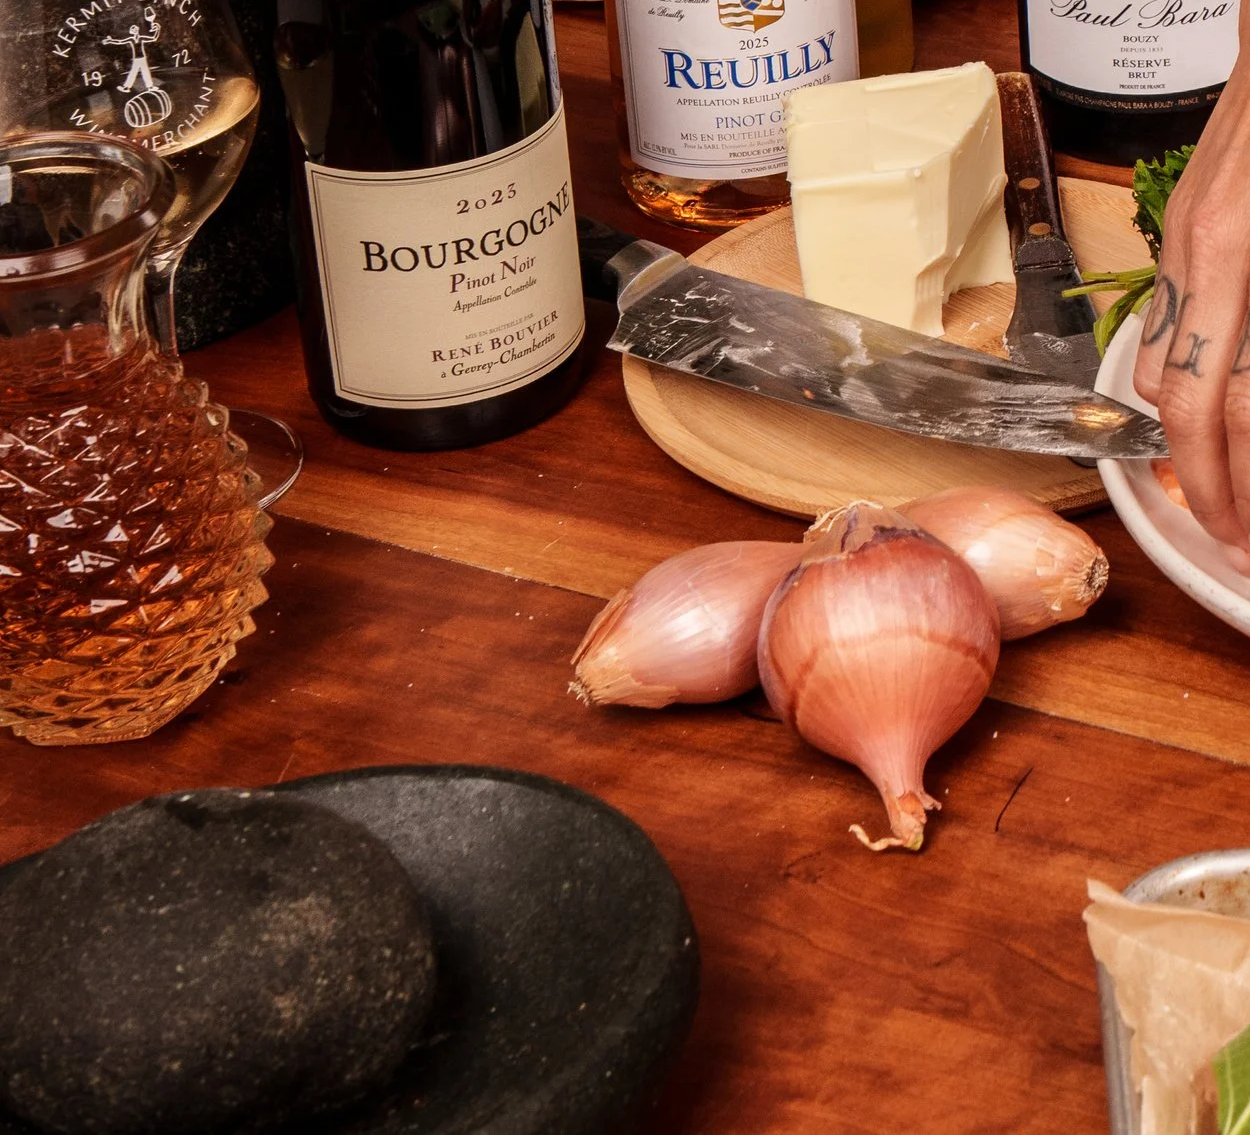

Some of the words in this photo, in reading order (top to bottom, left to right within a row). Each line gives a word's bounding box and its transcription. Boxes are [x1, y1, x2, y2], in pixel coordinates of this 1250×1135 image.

[739, 36, 769, 51] 2025
[1123, 35, 1159, 43] BOUZY
[81, 70, 103, 87] 19
[171, 49, 192, 67] 72
[658, 30, 836, 91] REUILLY
[1112, 57, 1171, 68] RÉSERVE
[1128, 71, 1157, 79] BRUT
[676, 97, 740, 107] APPELLATION
[742, 92, 781, 105] REUILLY
[716, 113, 766, 129] PINOT
[680, 132, 698, 141] MIS
[700, 133, 714, 142] EN
[717, 129, 776, 142] BOUTEILLE
[729, 149, 761, 158] PRODUCE
[456, 182, 517, 215] 2023
[360, 180, 570, 273] BOURGOGNE
[449, 272, 497, 294] Pinot
[500, 255, 537, 281] Noir
[453, 294, 502, 313] Appellation
[431, 341, 485, 363] RENÉ
[489, 310, 559, 351] BOUVIER
[451, 332, 556, 378] Gevrey-Chambertin
